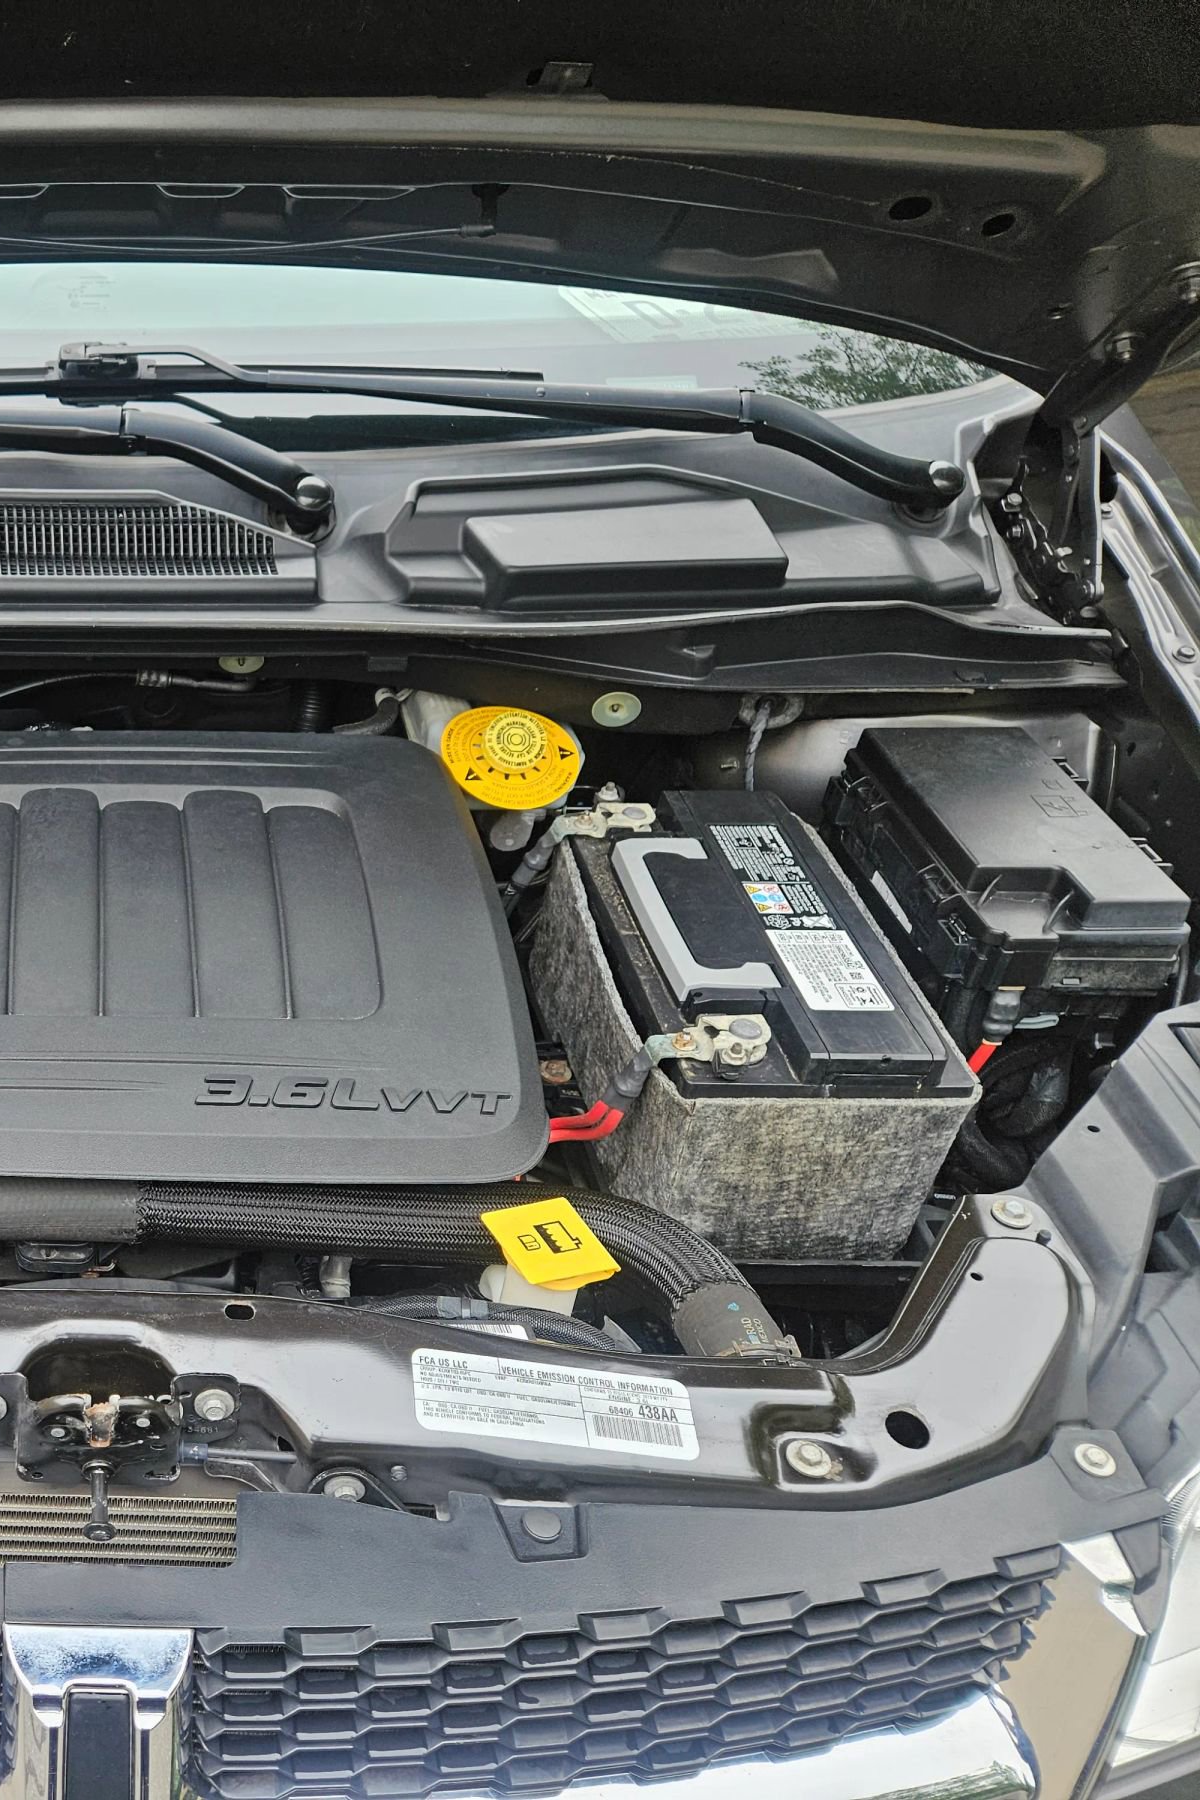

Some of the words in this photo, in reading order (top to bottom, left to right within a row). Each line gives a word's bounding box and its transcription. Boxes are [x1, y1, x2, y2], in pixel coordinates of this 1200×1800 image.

[194, 1073, 380, 1111] 3.6L
[381, 1086, 514, 1116] VVT
[740, 1317, 757, 1336] RAD
[418, 1355, 437, 1366] FCA
[437, 1357, 451, 1368] US
[451, 1359, 469, 1370] LLC
[501, 1365, 535, 1379] VEHICLE
[536, 1370, 576, 1384] EMISSION
[577, 1375, 616, 1389] CONTROL
[616, 1381, 673, 1396] INFORMATION
[608, 1405, 634, 1417] 68406
[638, 1405, 679, 1422] 438AA
